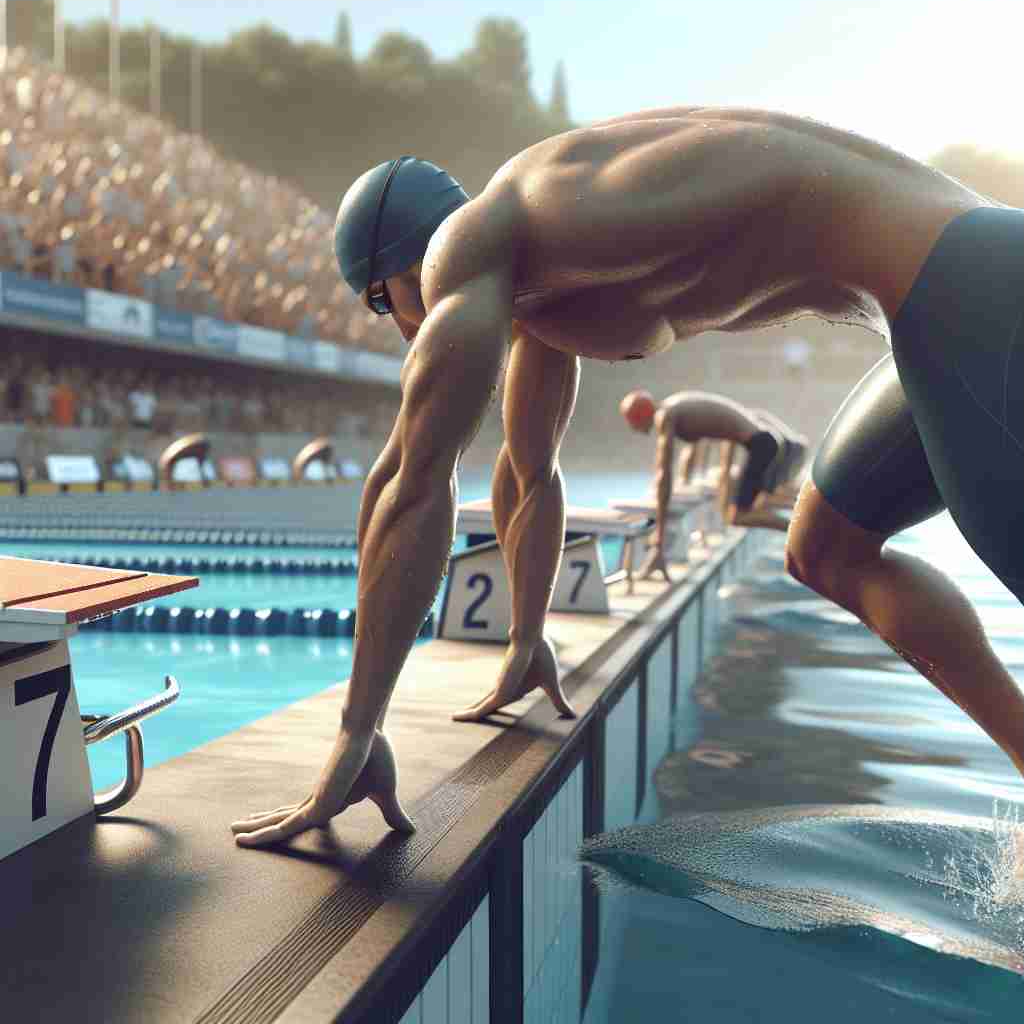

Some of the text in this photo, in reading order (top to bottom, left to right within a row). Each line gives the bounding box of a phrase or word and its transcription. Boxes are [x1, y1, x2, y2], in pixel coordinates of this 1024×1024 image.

[463, 573, 493, 629] 2
[569, 561, 590, 604] 7
[14, 664, 71, 822] 7
